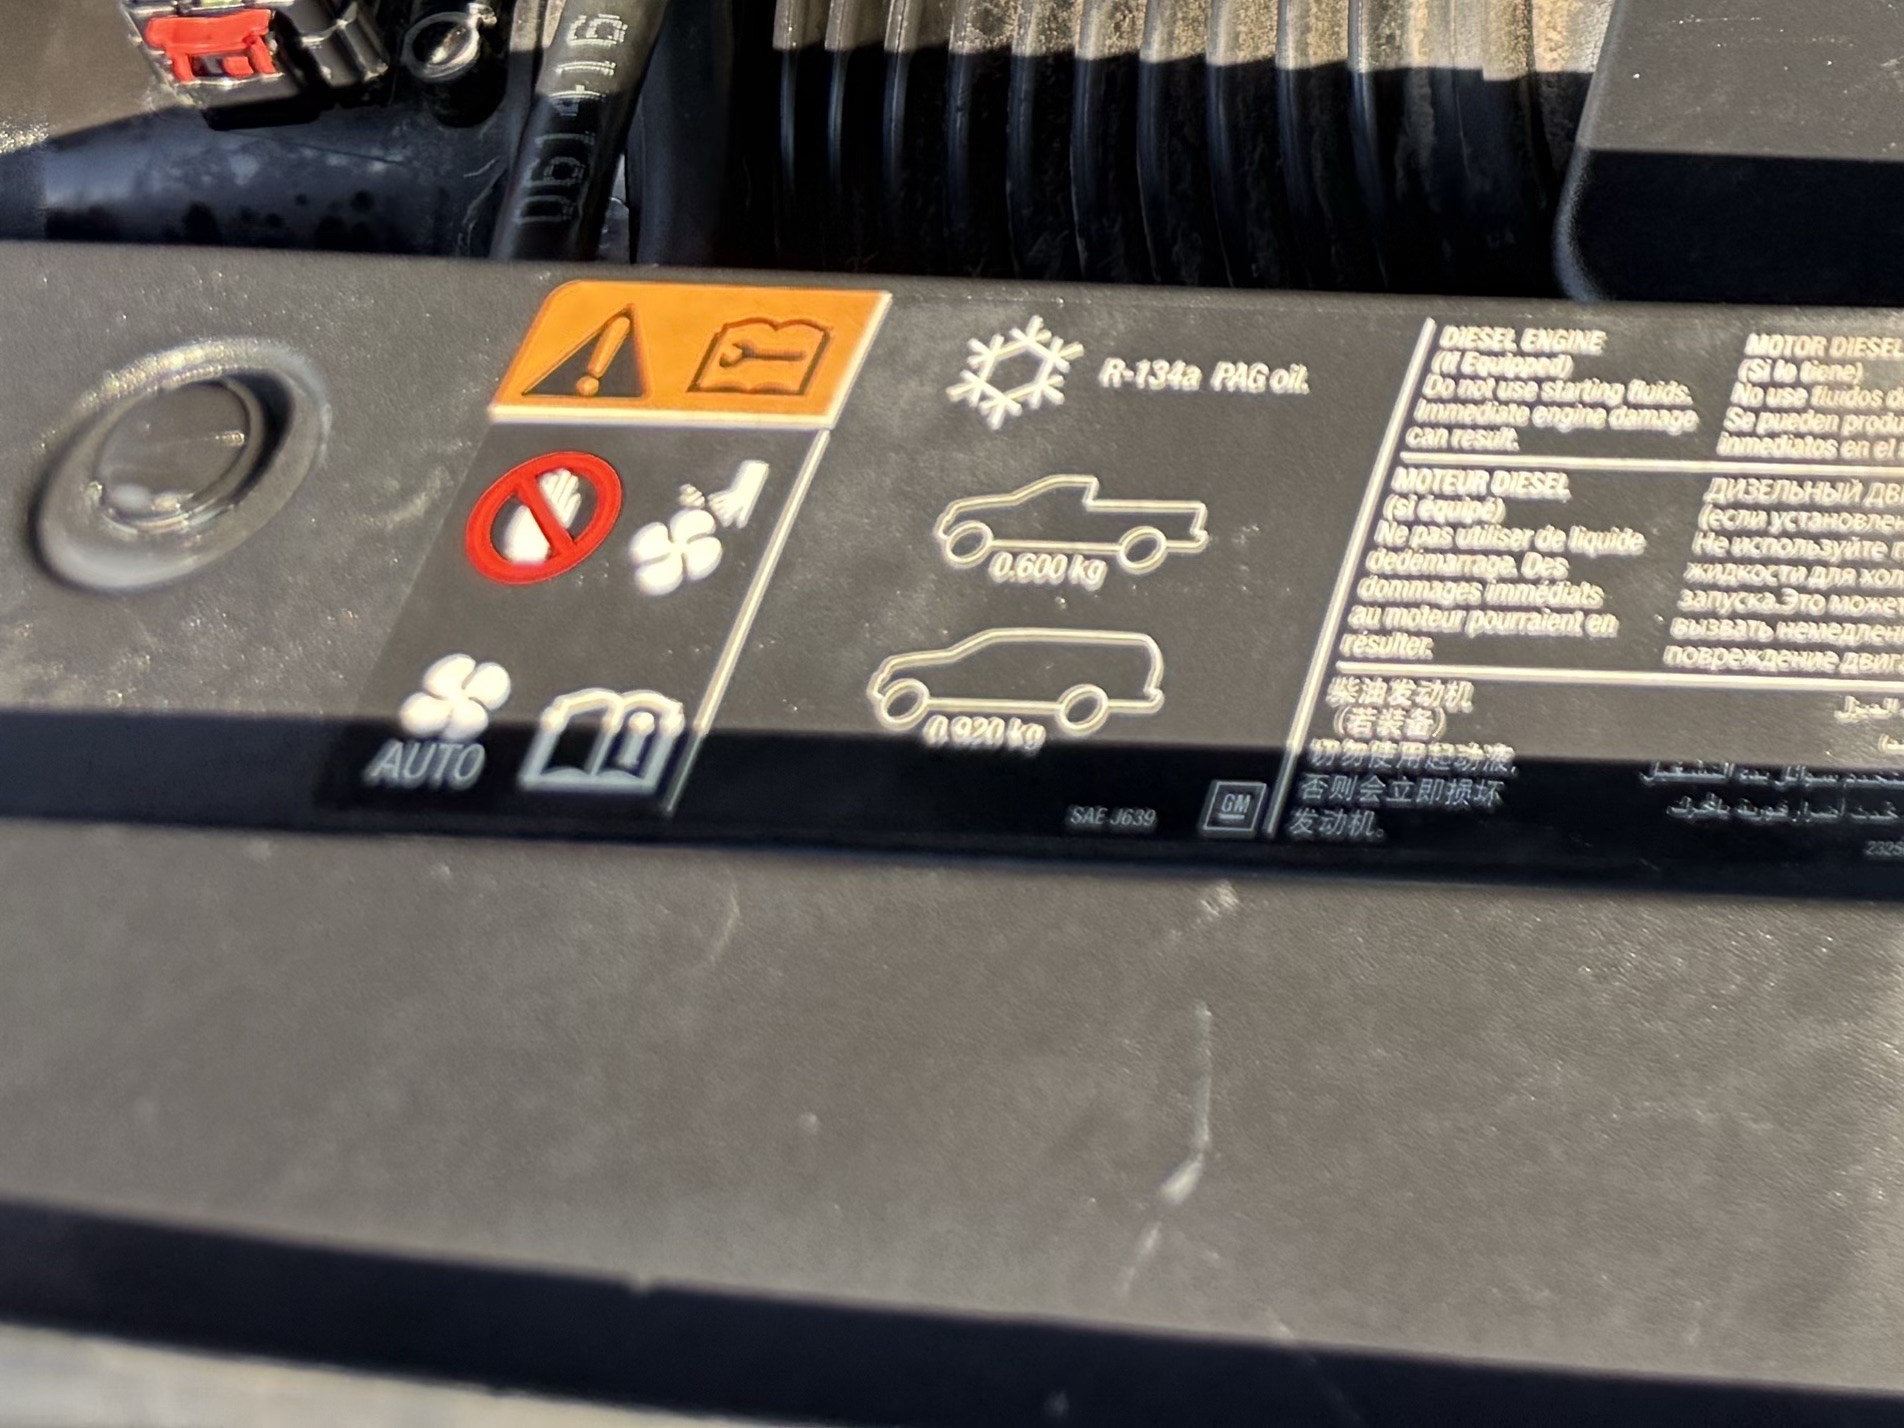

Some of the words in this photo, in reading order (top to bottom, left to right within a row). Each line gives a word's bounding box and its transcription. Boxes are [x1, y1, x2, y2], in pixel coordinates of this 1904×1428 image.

[1439, 325, 1517, 352] DIESEL
[1520, 328, 1608, 356] ENGINE
[1744, 333, 1828, 359] MOTOR
[1098, 356, 1203, 392] R-134a
[1208, 360, 1270, 394] PAG
[1460, 353, 1574, 379] Equipped)
[1737, 357, 1772, 383] (Si
[1773, 359, 1797, 383] lo
[1799, 361, 1863, 386] tiene)
[1422, 374, 1456, 399] Do
[1456, 378, 1496, 400] not
[1496, 380, 1538, 402] use
[1540, 378, 1625, 407] starting
[1626, 379, 1693, 405] fluids.
[1730, 381, 1765, 407] No
[1766, 387, 1808, 408] use
[1809, 385, 1884, 410] fluidos
[1413, 398, 1530, 426] Immediate
[1532, 404, 1608, 432] engine
[1608, 405, 1700, 436] damage
[1723, 407, 1755, 431] Se
[1756, 411, 1839, 435] pueden
[1405, 427, 1449, 449] can
[1450, 427, 1520, 452] result.
[1717, 431, 1838, 458] inmediatos
[1840, 438, 1869, 458] en
[1873, 436, 1897, 459] el
[1391, 467, 1490, 495] MOTEUR
[1491, 470, 1570, 501] DIESEL
[1703, 477, 1864, 506] ДИЗЕЛЬНЫЙ
[1382, 495, 1417, 521] (si
[1417, 496, 1506, 524] équipé)
[1698, 504, 1768, 531] (если
[1374, 520, 1410, 546] Ne
[1409, 526, 1454, 549] pas
[1455, 523, 1535, 551] utiliser
[1534, 525, 1567, 552] de
[1568, 526, 1647, 557] liquide
[1691, 532, 1730, 557] Не
[1731, 536, 1888, 564] используйте
[989, 551, 1068, 585] 0.600
[1067, 554, 1108, 592] kg
[1521, 552, 1570, 579] Des
[1683, 562, 1809, 587] жидкости
[1809, 565, 1856, 587] для
[1357, 575, 1483, 606] dommages
[1483, 579, 1605, 609] immédiats
[1347, 606, 1382, 629] au
[1382, 606, 1467, 633] moteur
[1465, 608, 1585, 639] pourraient
[1585, 614, 1619, 639] en
[1670, 616, 1775, 642] вызвать
[1339, 632, 1434, 660] résulter.
[1664, 643, 1840, 673] повреждение
[1326, 676, 1475, 713] 柴油发动机
[366, 738, 487, 790] AUTO
[1220, 793, 1252, 814] GM
[1300, 773, 1505, 809] 否则会立即损坏
[1069, 805, 1108, 826] SAE
[1109, 808, 1158, 828] J639
